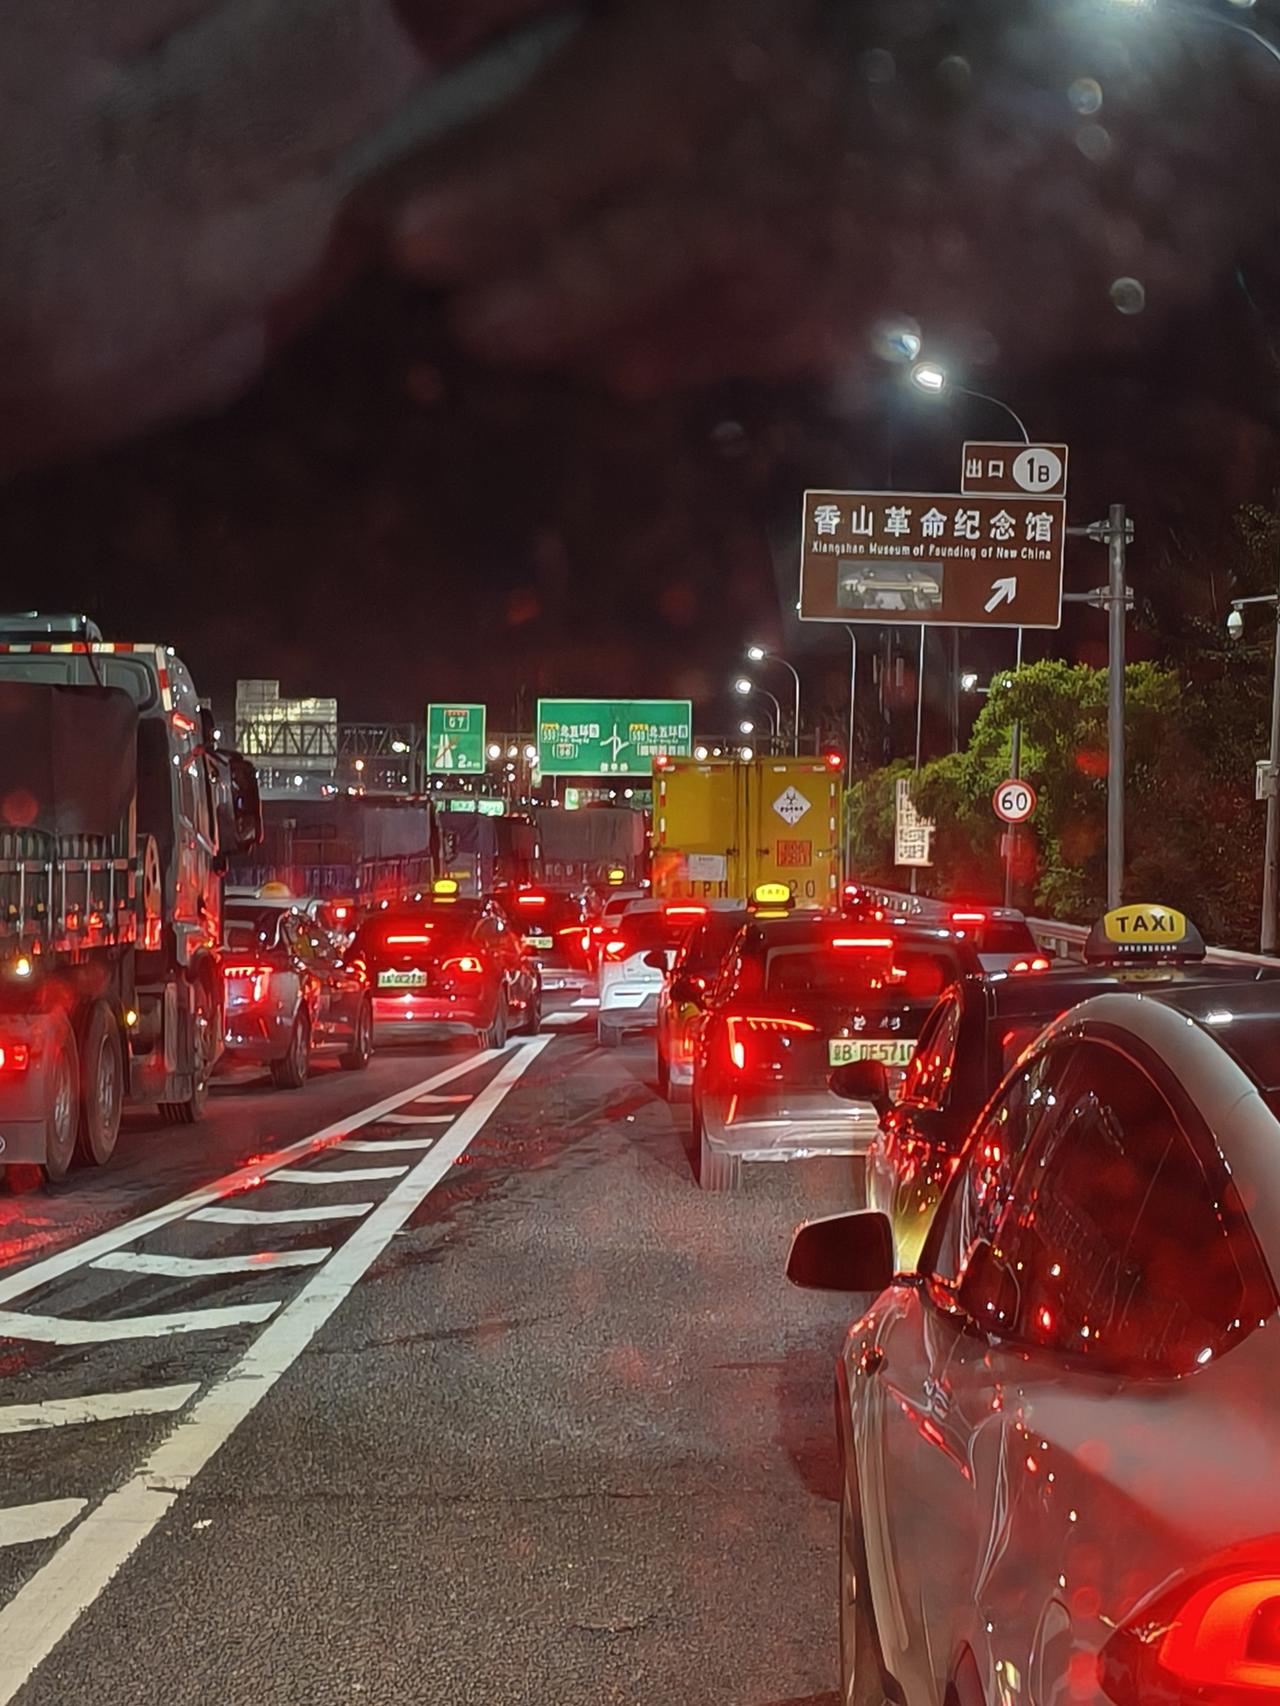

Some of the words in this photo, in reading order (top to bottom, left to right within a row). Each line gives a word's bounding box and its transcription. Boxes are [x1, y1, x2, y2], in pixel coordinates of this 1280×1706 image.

[965, 458, 1005, 479] 出口
[1026, 457, 1050, 483] 1B
[813, 504, 1054, 543] 香山革命纪念馆
[812, 541, 865, 557] Xiangshan
[869, 542, 911, 556] Museum
[912, 544, 925, 556] of
[928, 543, 977, 560] Founding
[980, 546, 994, 558] of
[996, 546, 1018, 559] New
[1020, 546, 1052, 560] China
[1001, 791, 1028, 812] 60
[1116, 914, 1176, 934] TAXI
